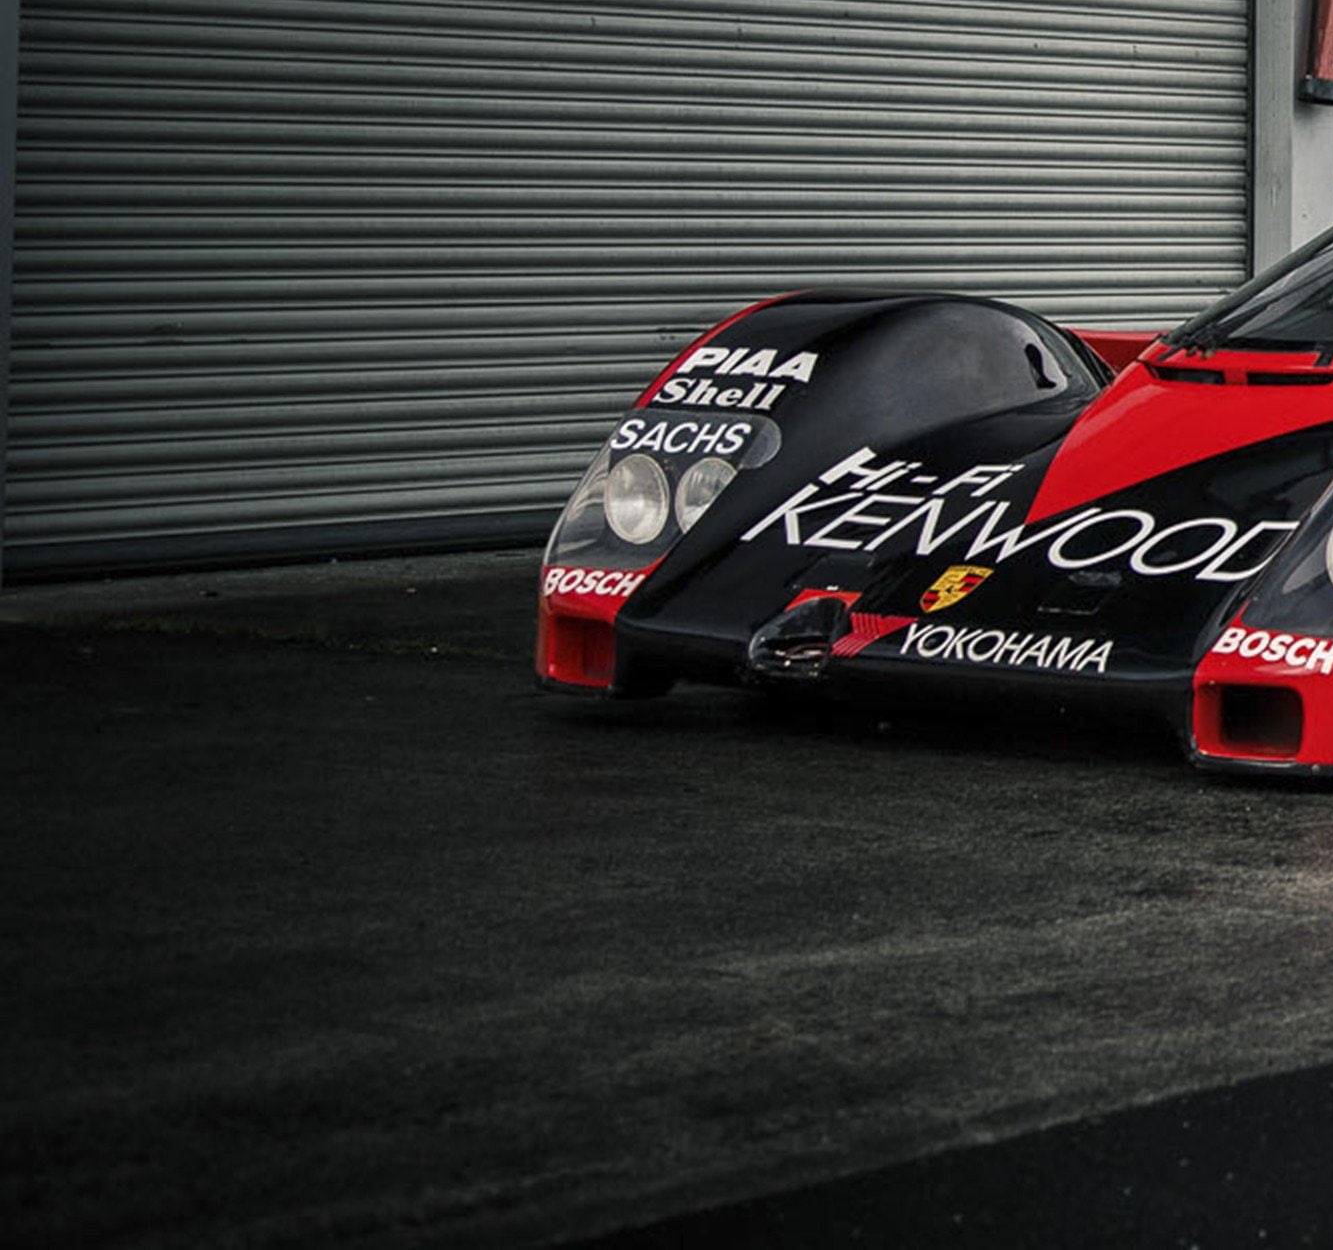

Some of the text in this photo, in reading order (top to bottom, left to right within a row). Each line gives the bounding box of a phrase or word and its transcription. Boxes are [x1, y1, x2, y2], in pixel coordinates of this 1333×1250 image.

[677, 347, 818, 383] PIAA
[652, 378, 786, 410] Shell
[610, 419, 751, 454] SACHS
[740, 483, 1299, 582] KENWOOD
[543, 568, 650, 598] BOSCH
[901, 623, 1113, 673] YOKOHAMA
